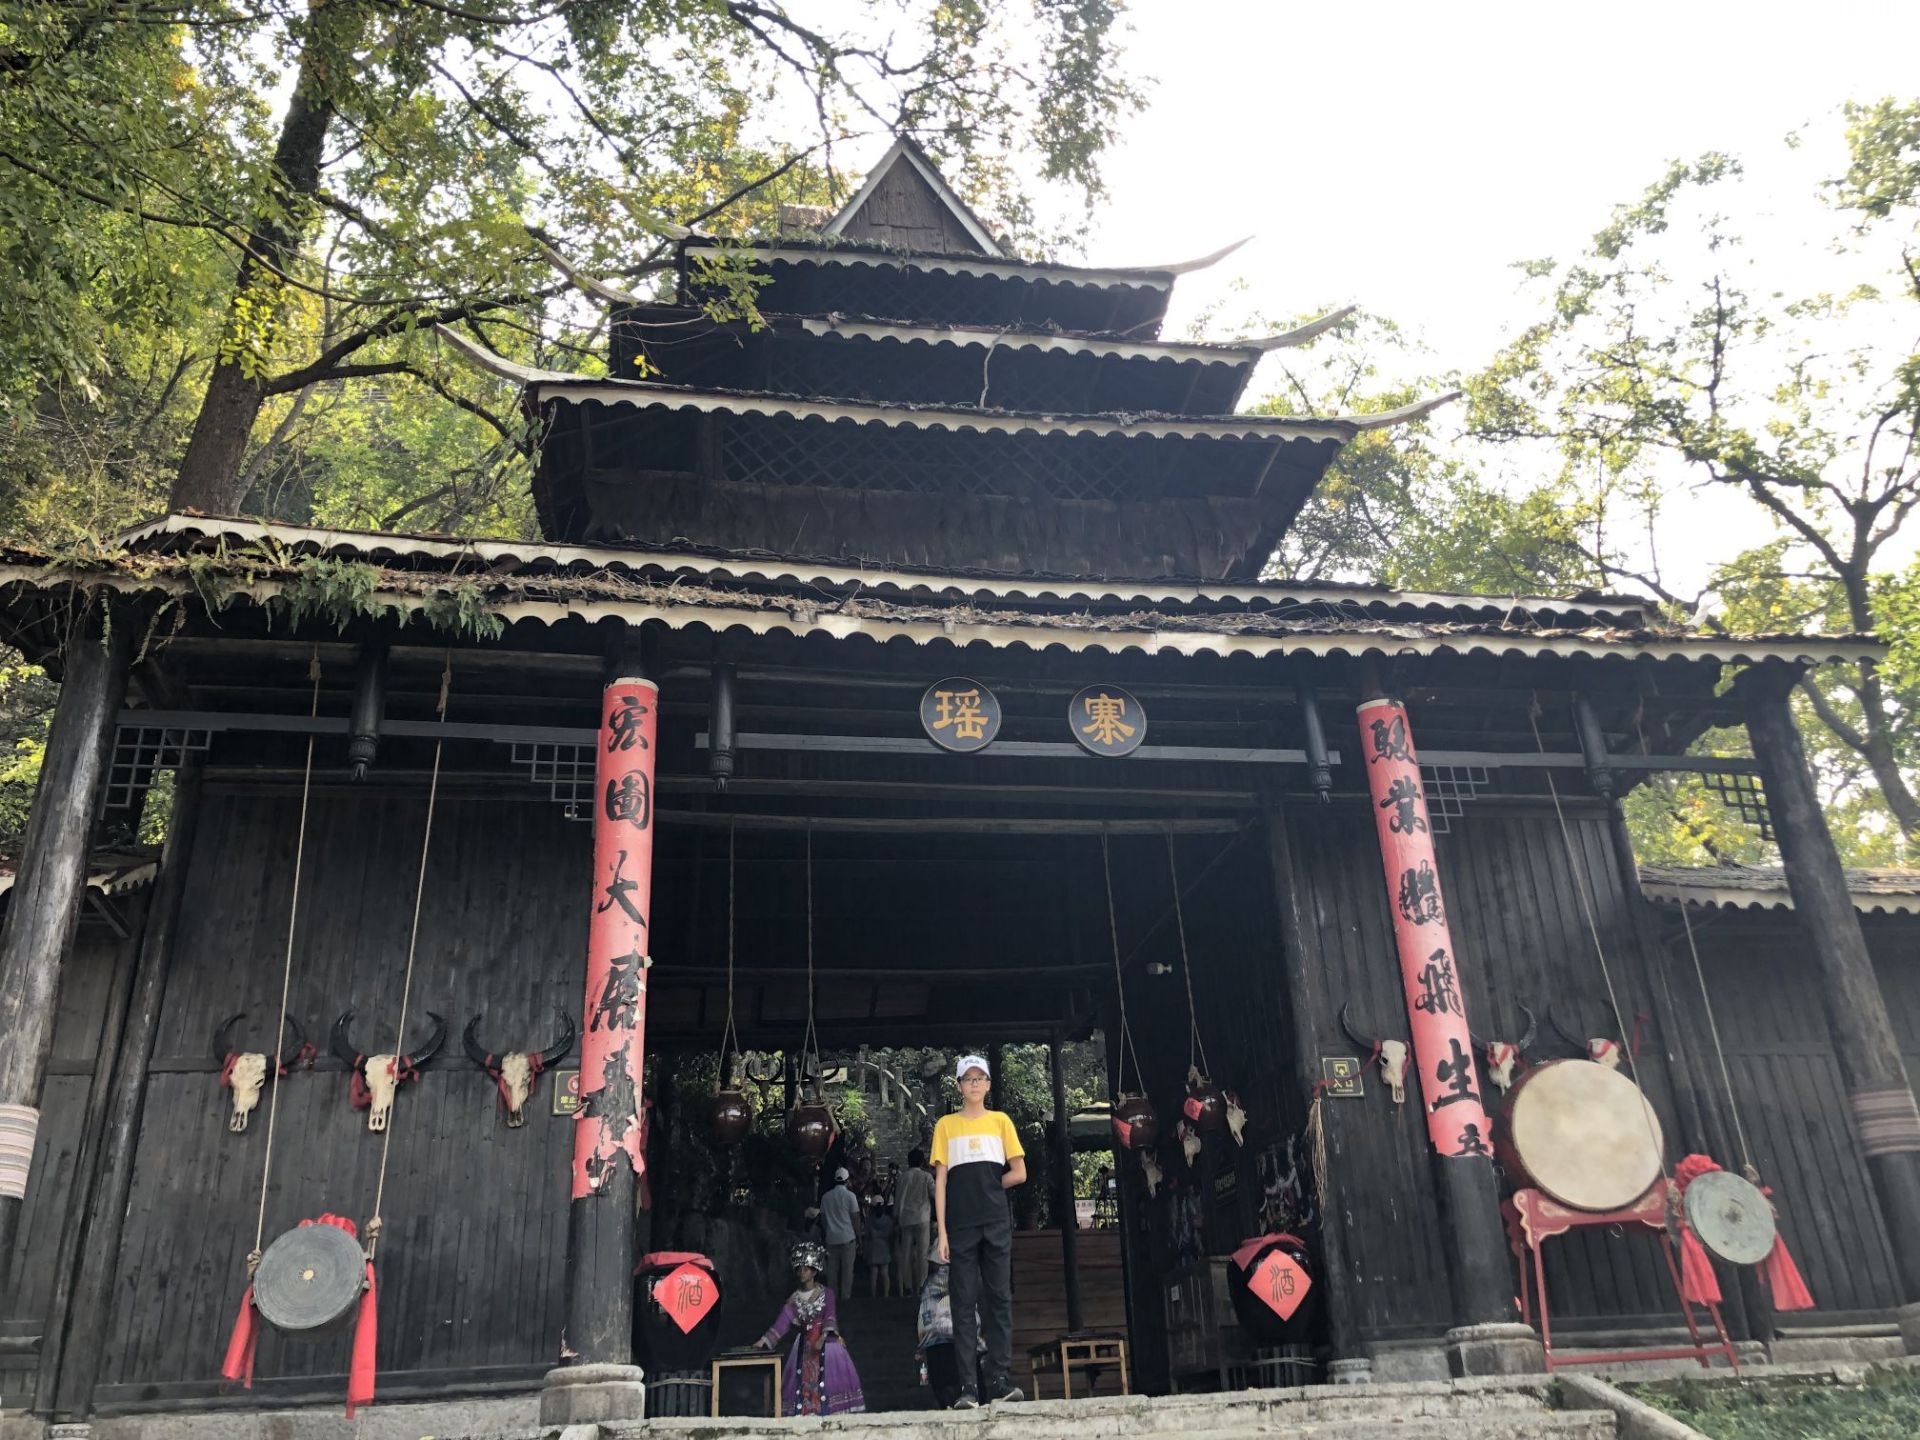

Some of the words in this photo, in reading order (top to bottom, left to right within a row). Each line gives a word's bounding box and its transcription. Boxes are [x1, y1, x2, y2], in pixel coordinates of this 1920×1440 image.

[1333, 1078, 1354, 1088] 入口
[677, 1271, 703, 1314] 酒
[1269, 1264, 1295, 1303] 酒
